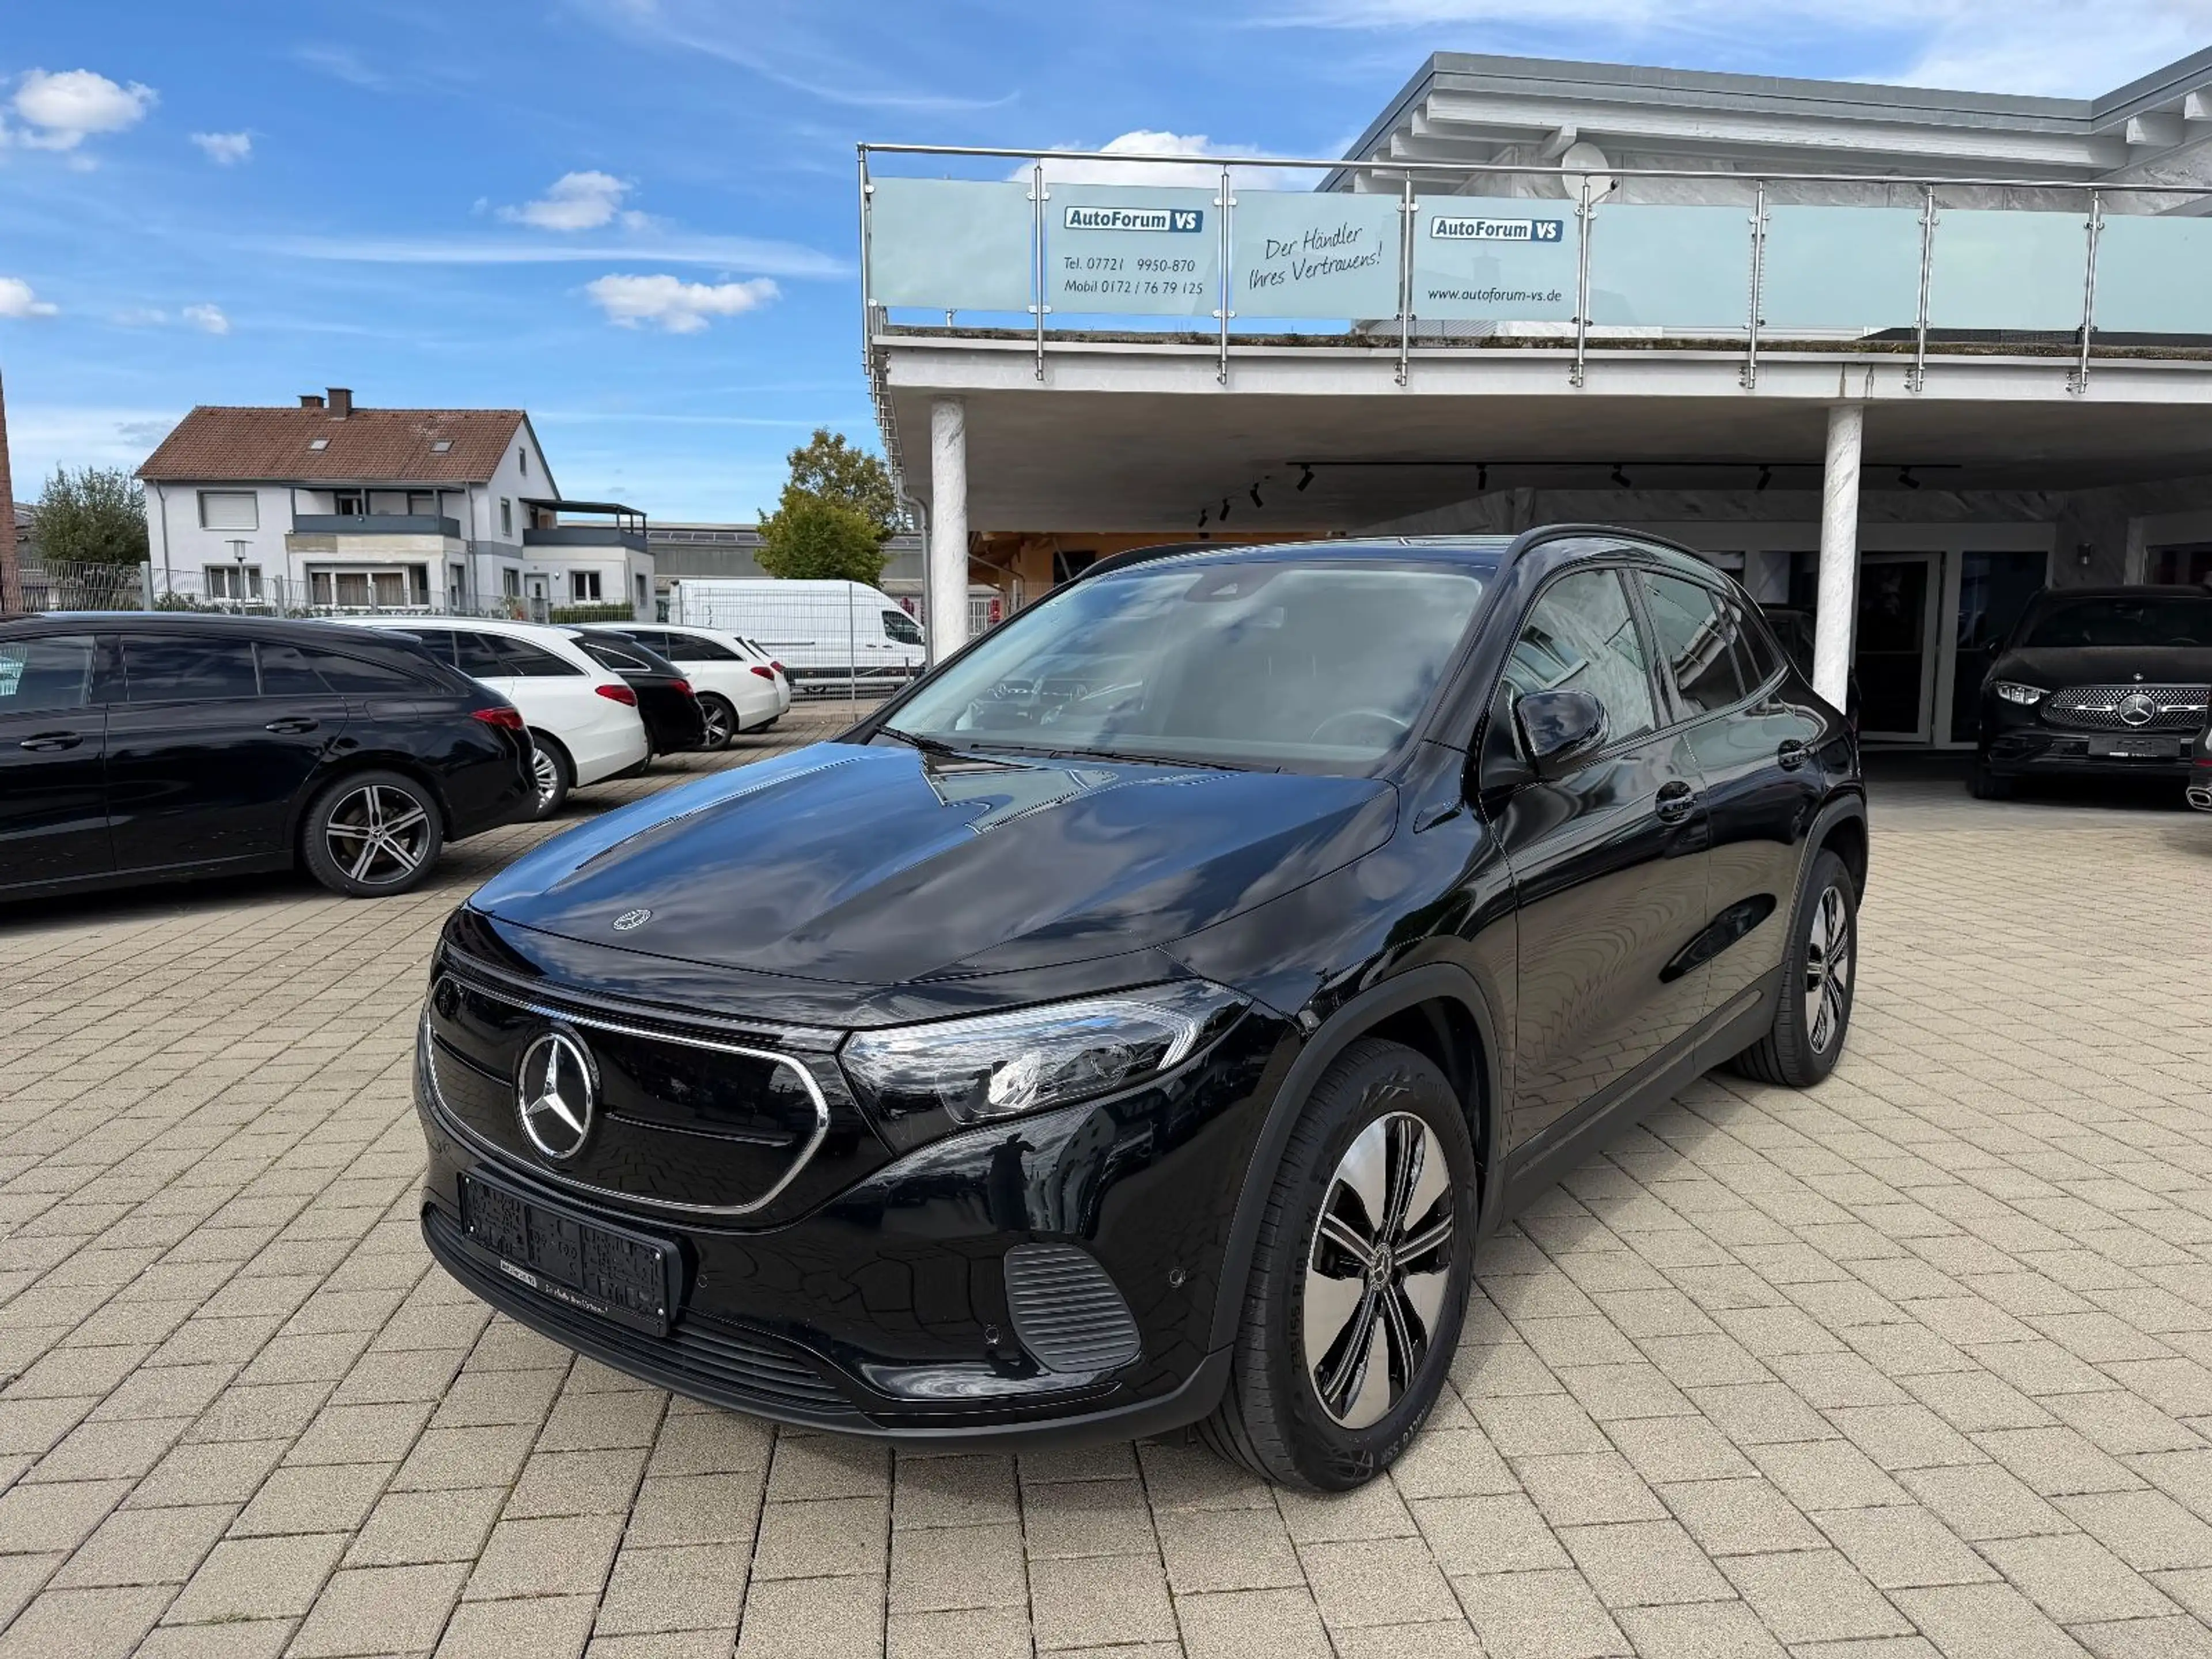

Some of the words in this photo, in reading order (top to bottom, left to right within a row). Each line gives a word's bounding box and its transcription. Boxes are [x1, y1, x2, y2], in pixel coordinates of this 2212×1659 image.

[1070, 210, 1166, 228] AutoForum
[1175, 213, 1196, 229] VS
[1436, 219, 1527, 237] AutoForum
[1536, 222, 1556, 239] VS
[1266, 239, 1297, 259] Der
[1303, 222, 1362, 252] Händler
[1064, 257, 1082, 270] Tel.
[1086, 257, 1123, 270] 07721
[1137, 259, 1195, 272] 9950-870
[1249, 269, 1285, 290] Ihres
[1292, 240, 1382, 281] Vertrauens!
[1064, 279, 1097, 292] Mobil
[1101, 280, 1131, 293] 0172
[1145, 282, 1158, 294] 76
[1162, 282, 1177, 294] 79
[1183, 282, 1203, 294] 125
[1428, 287, 1562, 303] www.autoforum-vs.de
